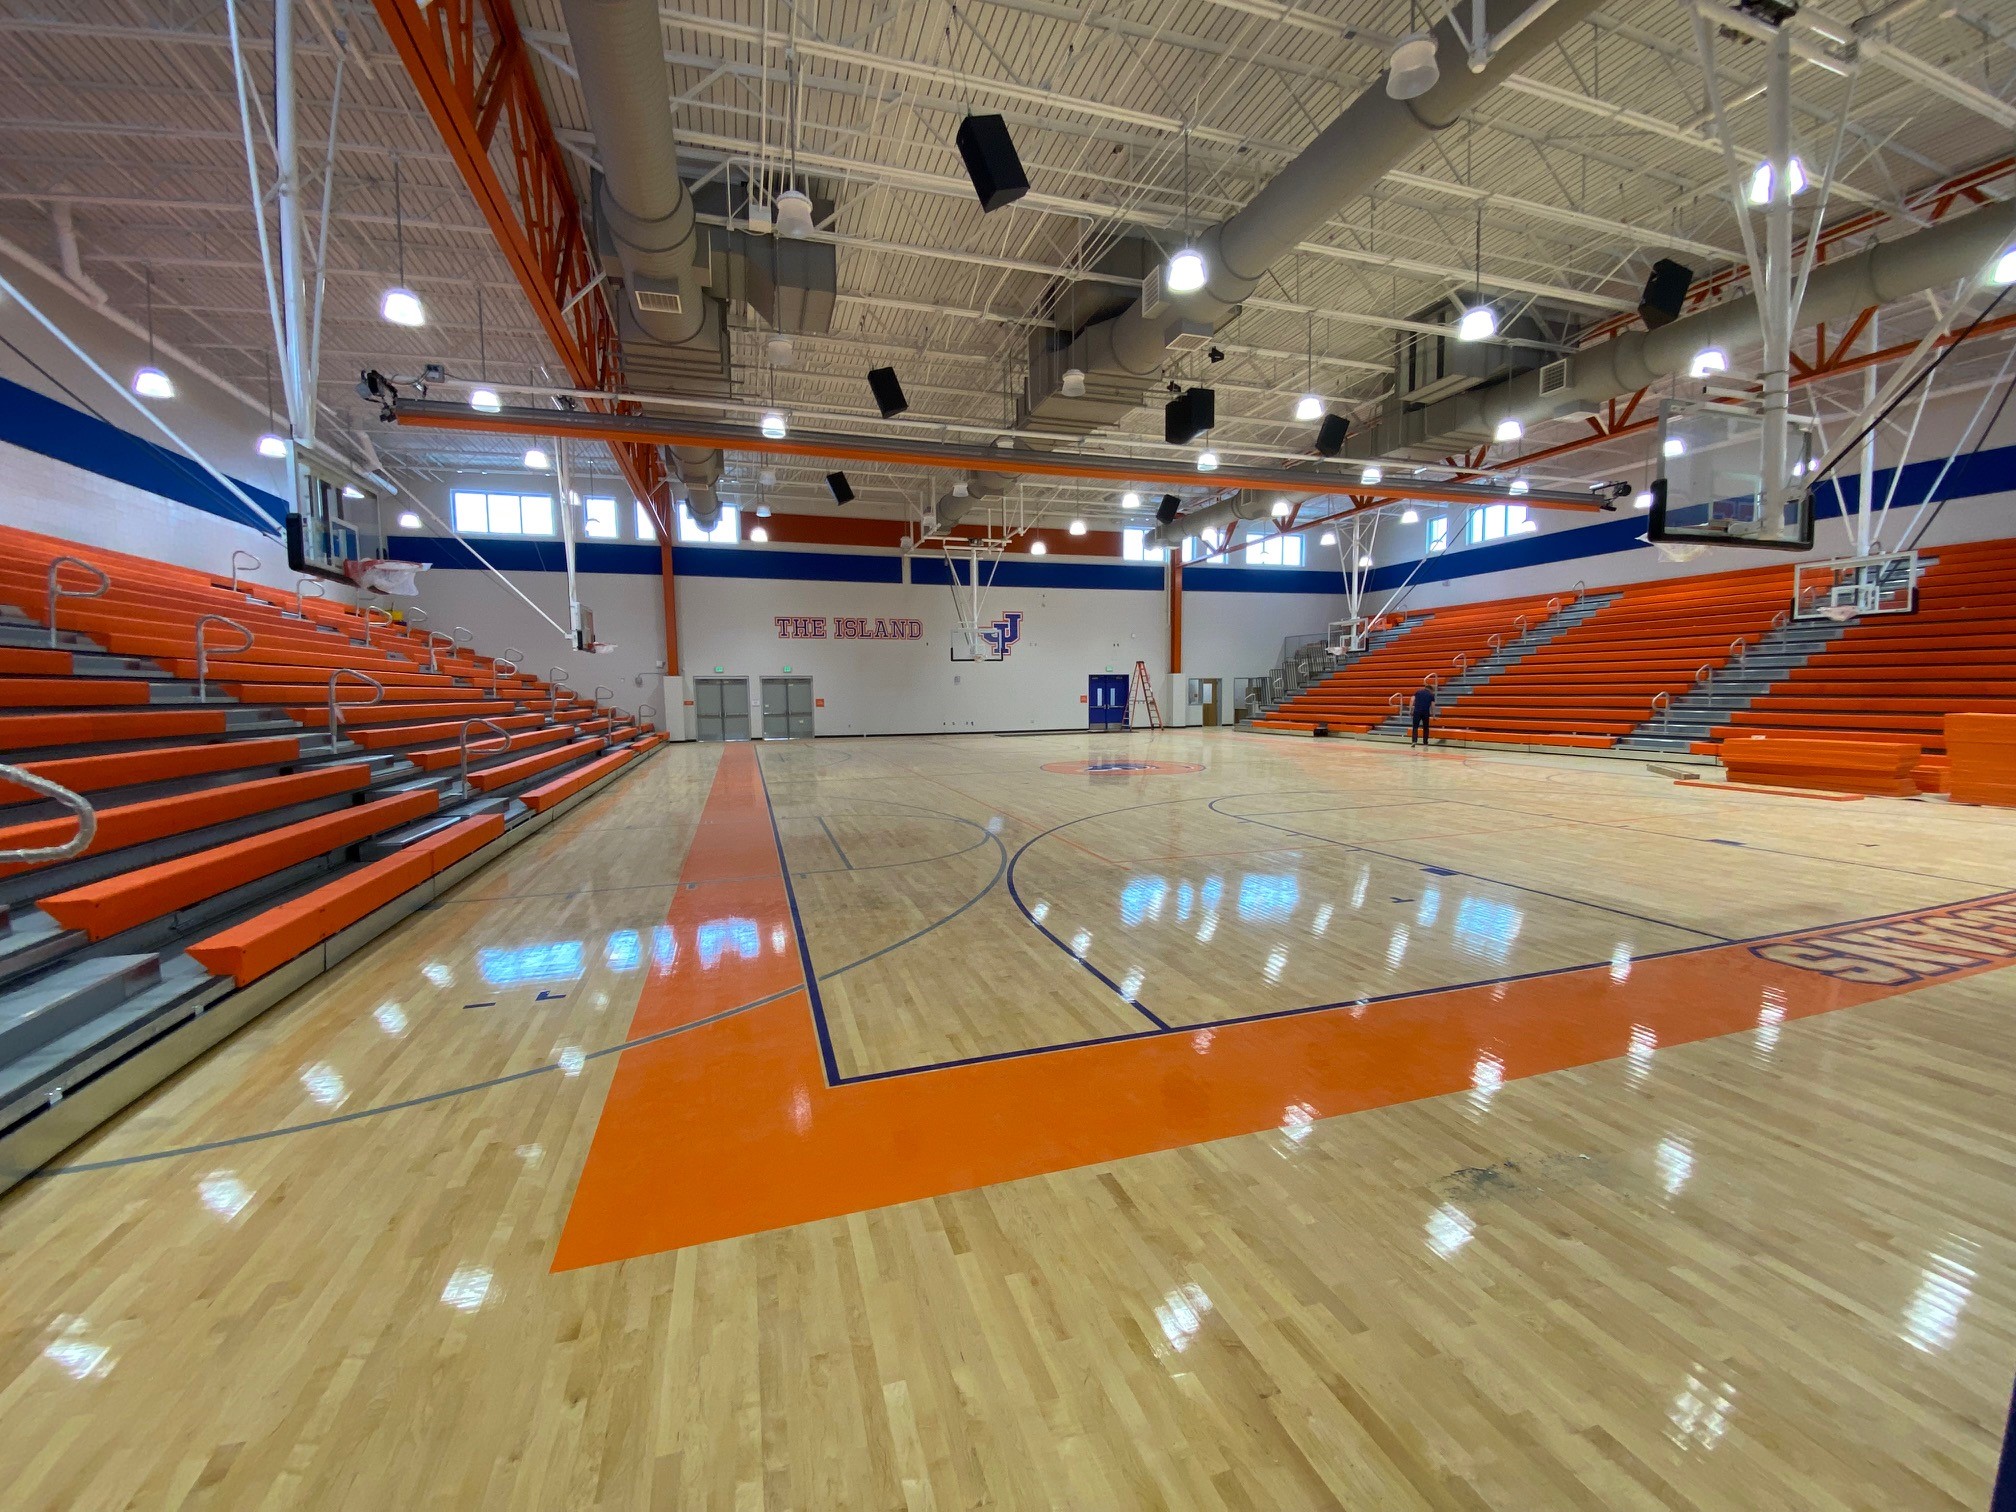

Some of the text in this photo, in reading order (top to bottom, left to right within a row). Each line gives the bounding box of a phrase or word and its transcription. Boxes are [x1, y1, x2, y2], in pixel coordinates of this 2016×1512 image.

[774, 617, 923, 640] THE ISLAND
[1747, 898, 2016, 987] JANS
